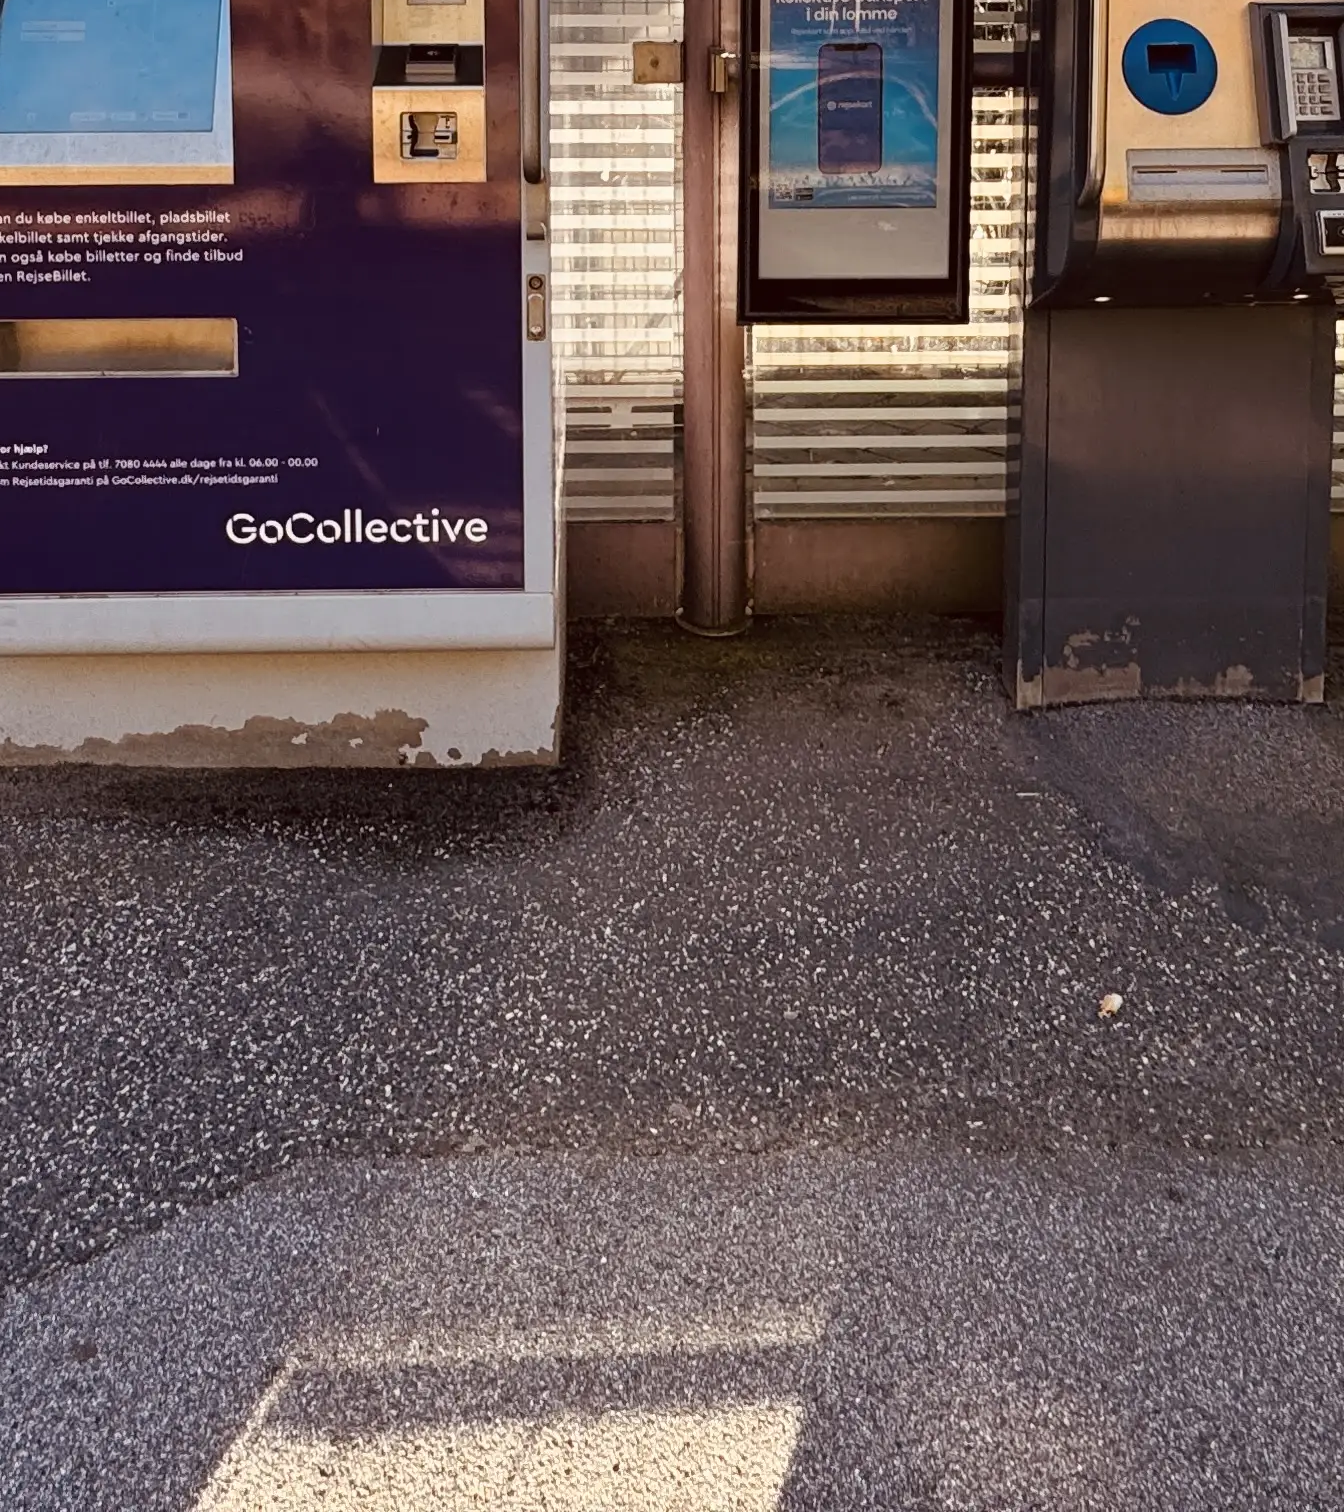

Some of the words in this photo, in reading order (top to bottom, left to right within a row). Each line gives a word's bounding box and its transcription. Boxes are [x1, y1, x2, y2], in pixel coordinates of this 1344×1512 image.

[806, 7, 811, 22] i
[814, 7, 839, 21] din
[843, 6, 898, 21] lomme
[15, 212, 33, 224] du
[36, 211, 71, 224] købe
[75, 211, 156, 226] enkeltbillet,
[160, 210, 231, 226] pladsbillet
[56, 233, 90, 244] samt
[93, 230, 134, 246] tjekke
[138, 230, 229, 245] afgangstider.
[11, 250, 44, 265] også
[48, 250, 82, 263] købe
[86, 250, 140, 263] billetter
[143, 252, 162, 264] og
[166, 249, 200, 262] finde
[203, 249, 244, 261] tilbud
[16, 269, 92, 284] RejseBillet.
[14, 444, 49, 455] hjælp?
[11, 460, 80, 470] Kundeservice
[83, 459, 96, 471] på
[98, 459, 113, 470] tlf.
[114, 459, 141, 469] 7080
[143, 459, 167, 468] 4444
[169, 458, 187, 468] alle
[190, 458, 217, 470] dage
[218, 458, 233, 468] fra
[234, 458, 246, 467] kl.
[248, 458, 279, 468] 06.00
[287, 458, 319, 467] 00.00
[12, 475, 94, 487] Rejsetidsgaranti
[96, 475, 109, 487] på
[111, 473, 278, 486] GoCollective.dk/rejsetidsgaranti
[225, 507, 488, 544] GoCollective
